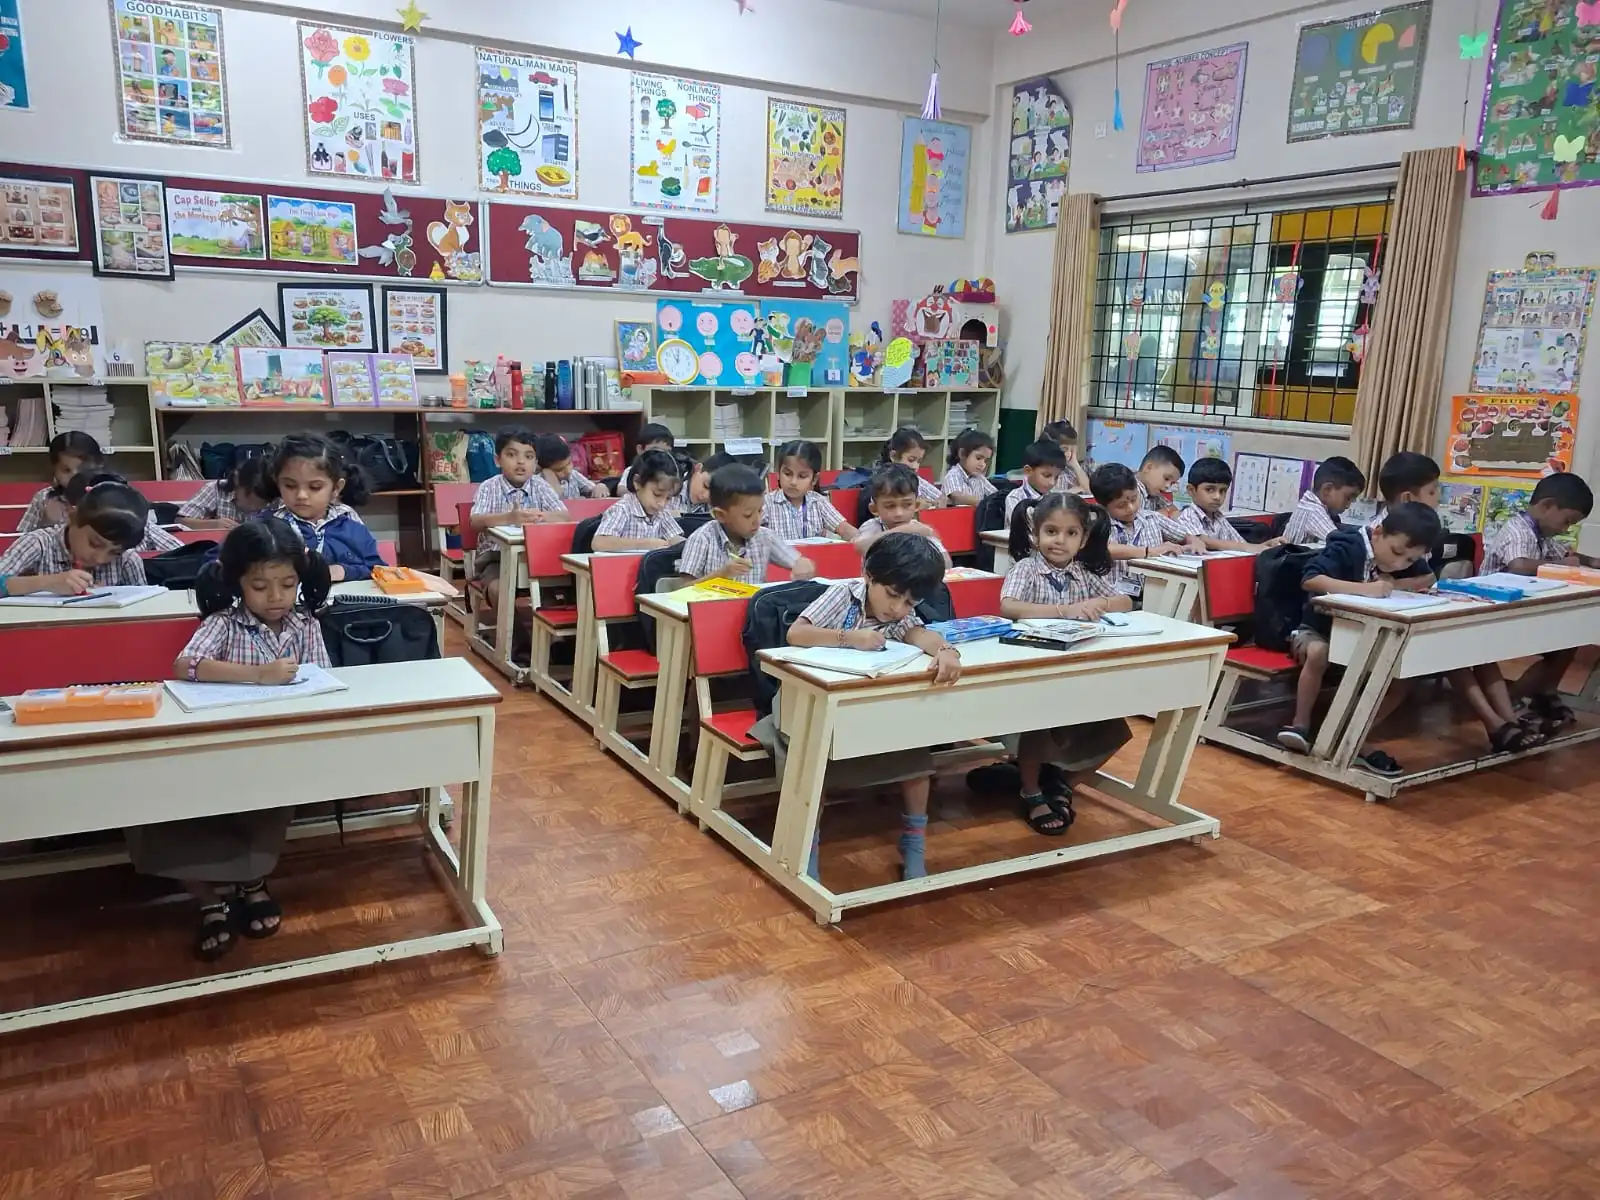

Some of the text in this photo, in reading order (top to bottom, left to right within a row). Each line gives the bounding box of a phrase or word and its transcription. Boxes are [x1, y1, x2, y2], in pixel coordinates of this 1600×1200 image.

[374, 31, 414, 45] FLOWERS
[479, 53, 524, 68] NATURAL
[526, 60, 547, 71] MAN
[635, 78, 663, 90] LIVING
[635, 86, 667, 98] THINGS
[688, 93, 717, 105] THINGS
[353, 111, 377, 121] USES
[509, 180, 542, 192] THINGS
[174, 194, 217, 207] Cap Seller
[174, 211, 186, 219] the
[113, 352, 120, 362] 6
